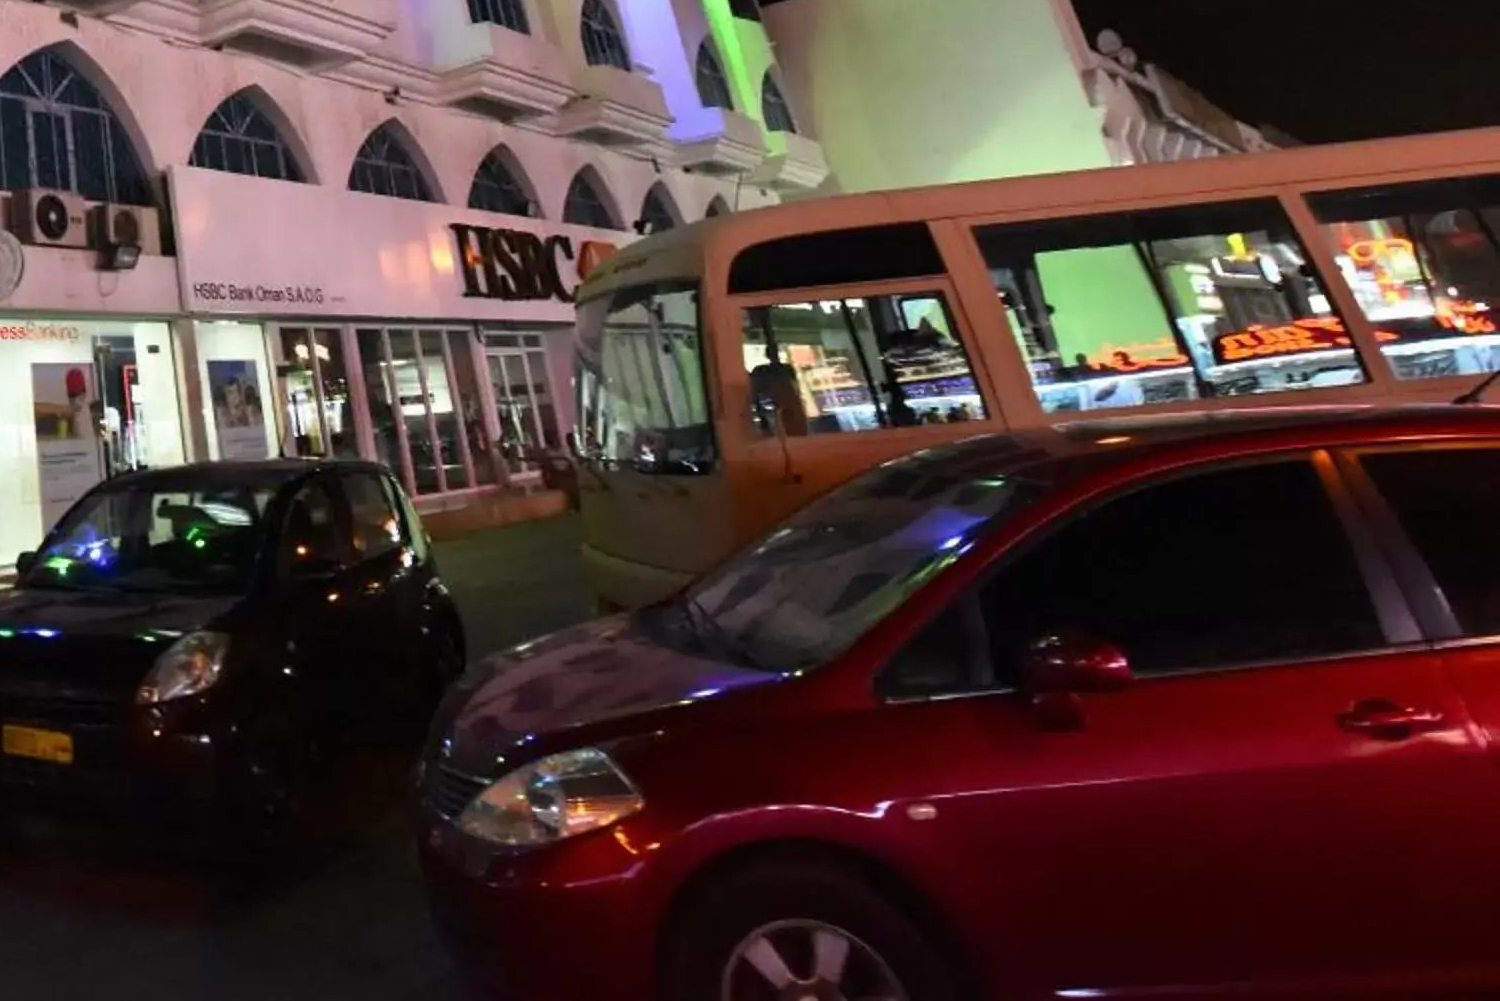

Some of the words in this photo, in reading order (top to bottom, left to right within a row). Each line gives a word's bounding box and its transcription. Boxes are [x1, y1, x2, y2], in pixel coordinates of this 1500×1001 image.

[449, 223, 576, 303] HSBC
[193, 282, 226, 300] HSBC
[228, 284, 253, 300] Bank
[256, 285, 283, 301] Oman
